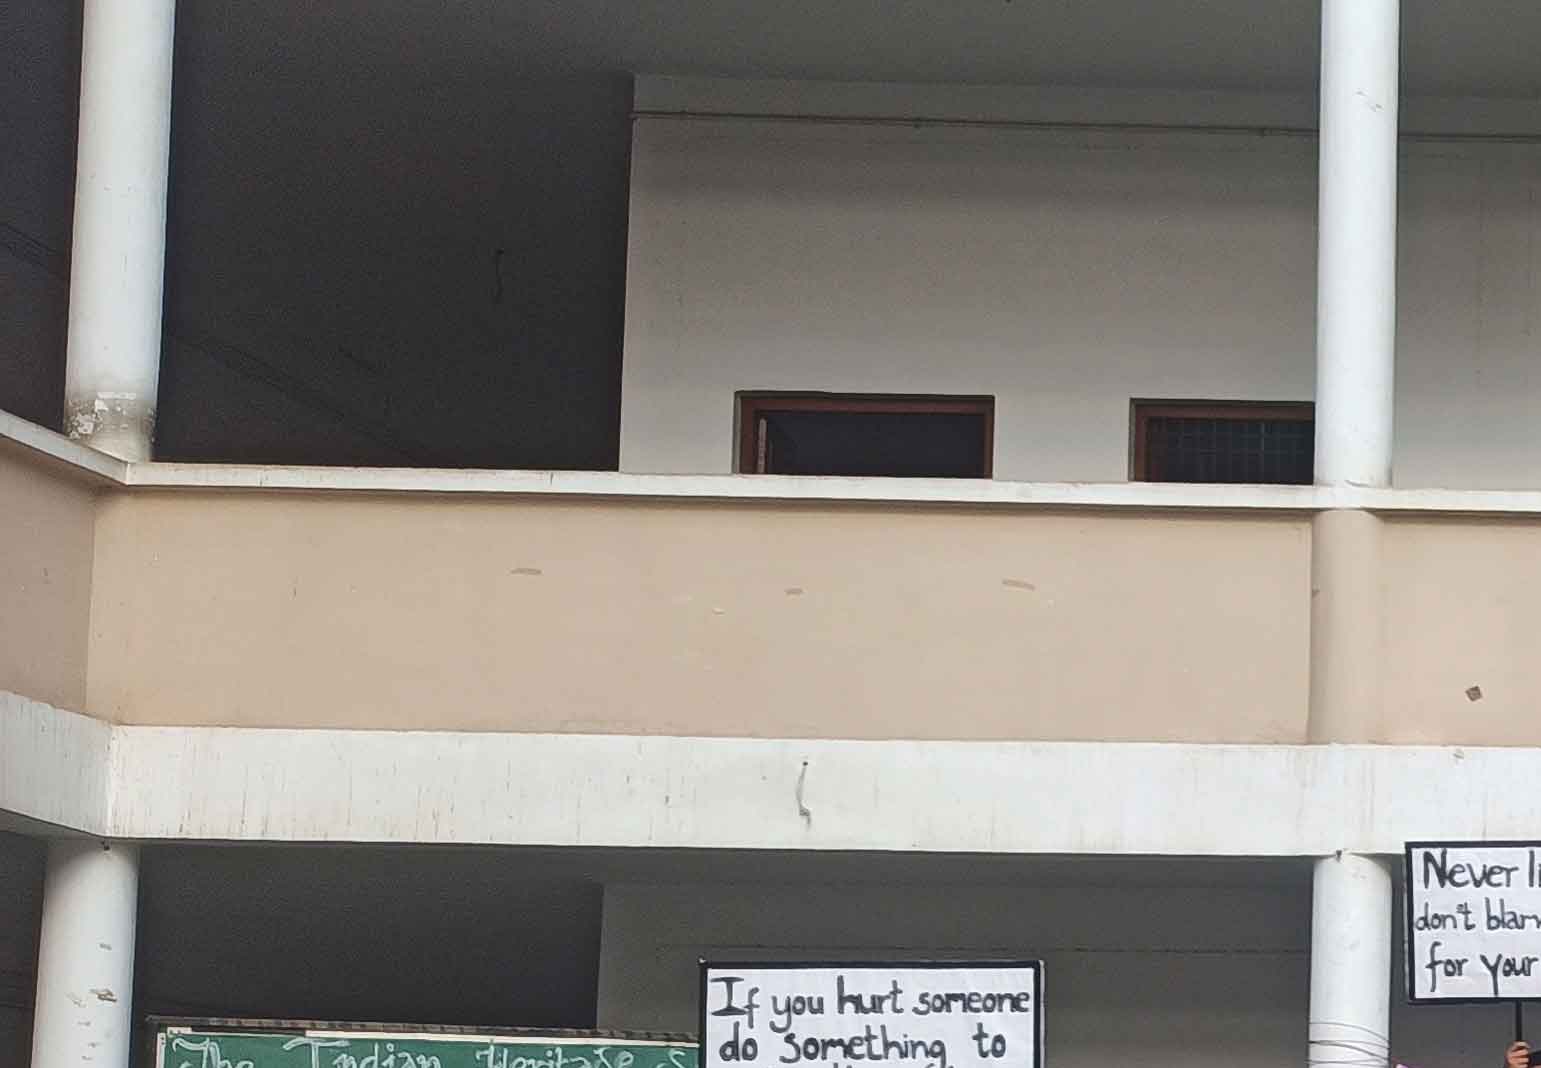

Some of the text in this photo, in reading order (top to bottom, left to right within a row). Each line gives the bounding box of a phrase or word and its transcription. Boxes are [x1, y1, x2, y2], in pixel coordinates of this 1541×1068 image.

[1423, 848, 1519, 889] Never
[1415, 902, 1476, 931] don't
[1425, 941, 1469, 992] for
[1480, 953, 1539, 996] your
[711, 975, 1030, 1032] If you hurt someone
[719, 1021, 758, 1061] do
[972, 1023, 1006, 1058] to
